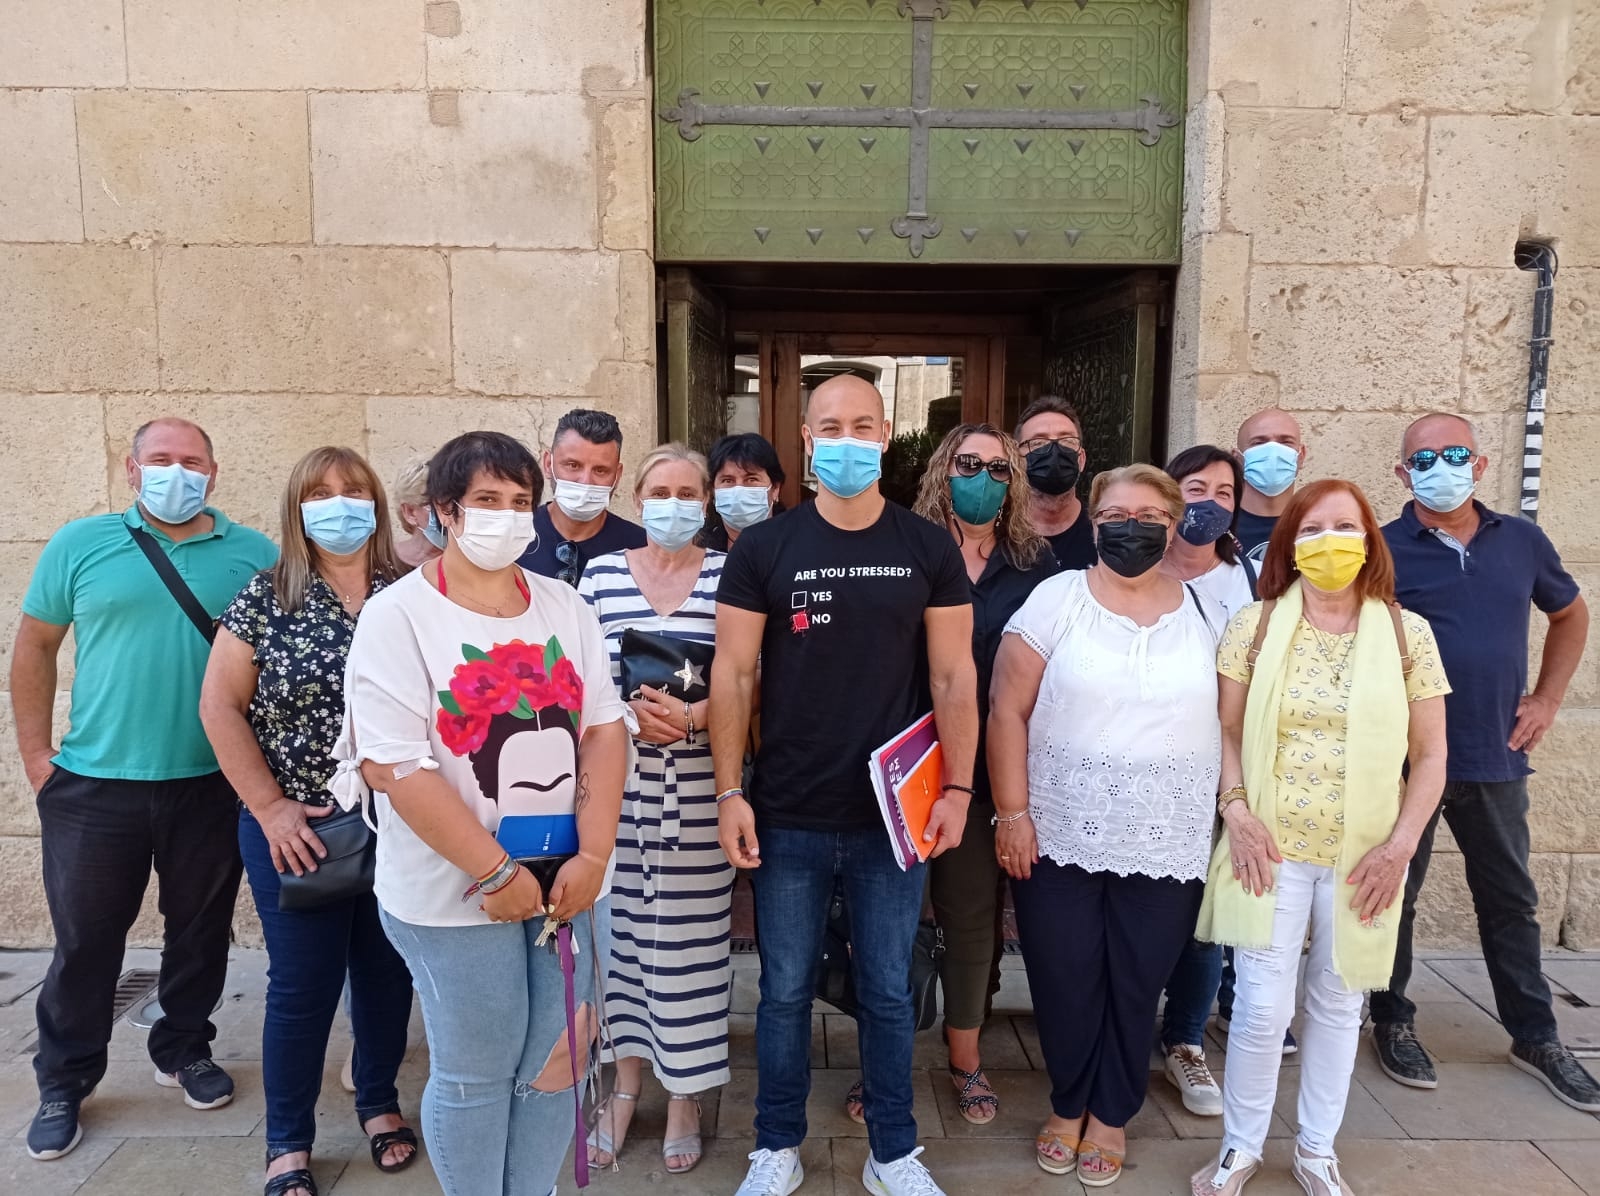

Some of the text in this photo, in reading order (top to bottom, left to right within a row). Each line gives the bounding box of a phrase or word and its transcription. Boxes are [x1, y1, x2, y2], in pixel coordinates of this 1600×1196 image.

[794, 566, 912, 582] ARE YOU STRESSED?
[811, 591, 833, 602] YES
[811, 613, 831, 625] NO
